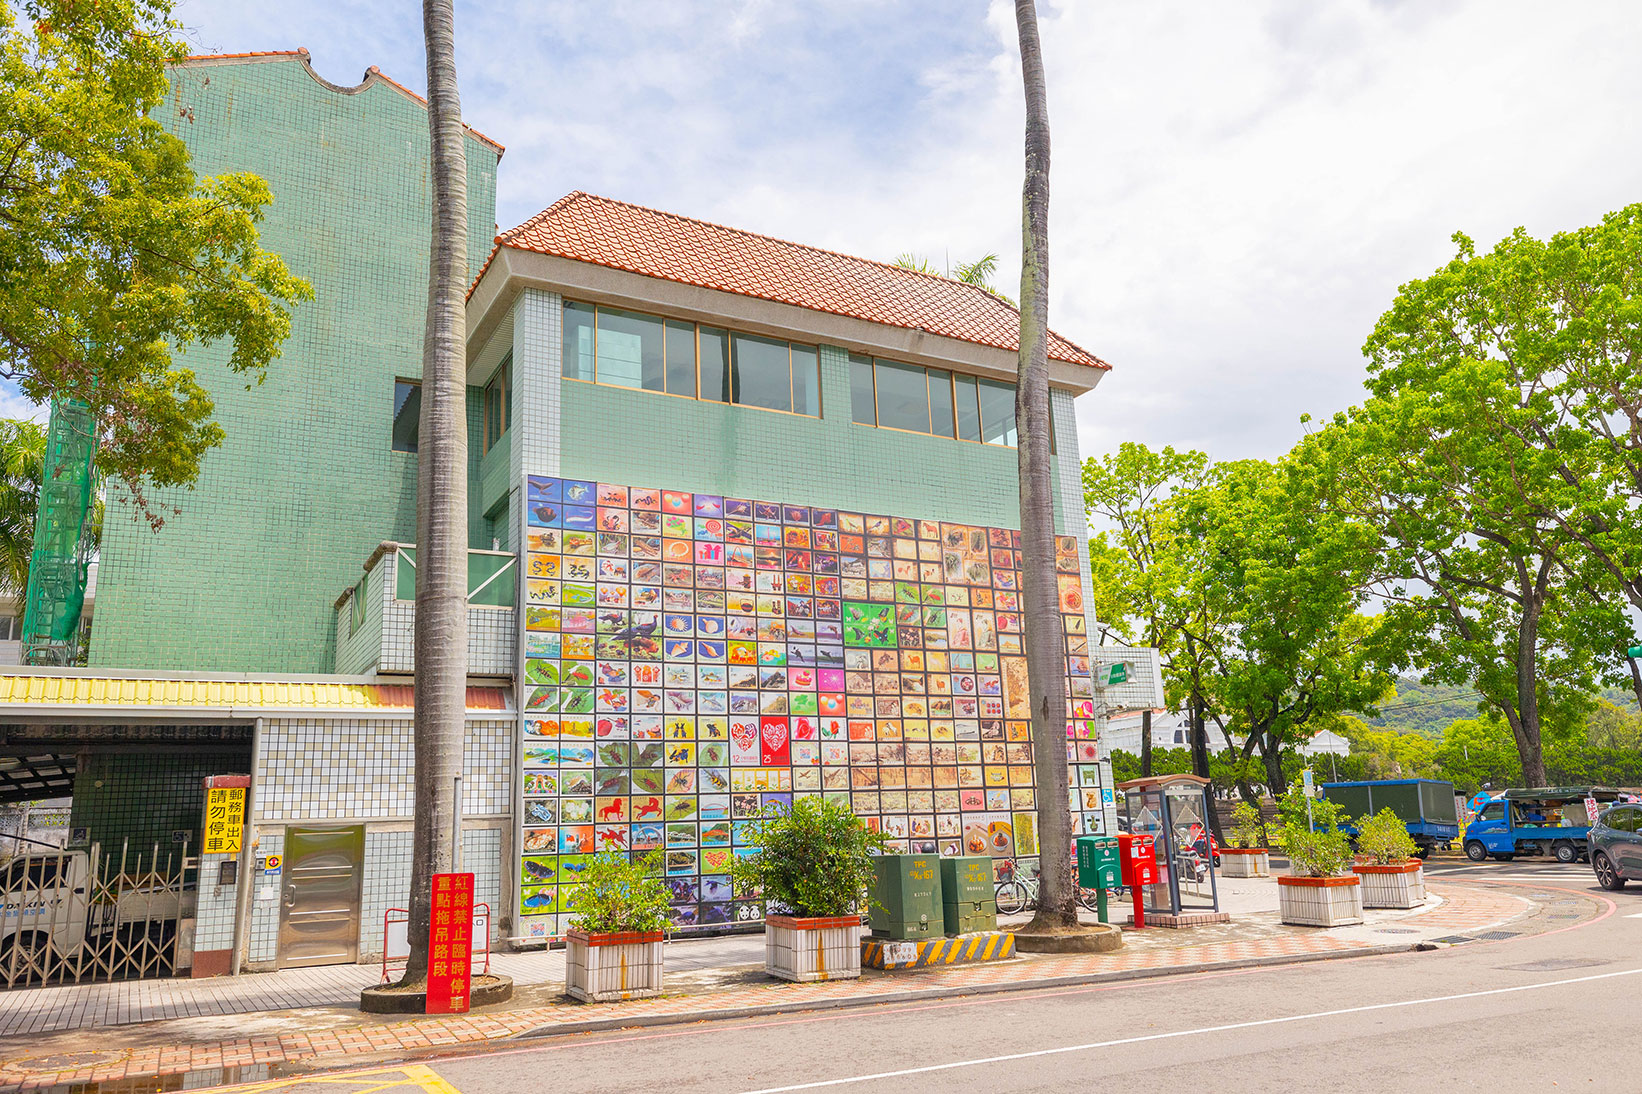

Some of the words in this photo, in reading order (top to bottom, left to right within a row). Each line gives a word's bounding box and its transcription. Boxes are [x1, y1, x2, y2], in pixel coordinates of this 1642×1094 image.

[732, 754, 740, 763] 12
[763, 754, 772, 764] 25
[207, 789, 227, 851] 請勿停車
[226, 789, 243, 851] 郵務車出入
[913, 861, 927, 869] TPC
[968, 864, 980, 872] TPC
[6, 901, 46, 909] DAKIN
[433, 876, 452, 977] 重點拖吊路段
[449, 875, 469, 1011] 紅線禁止臨時停車
